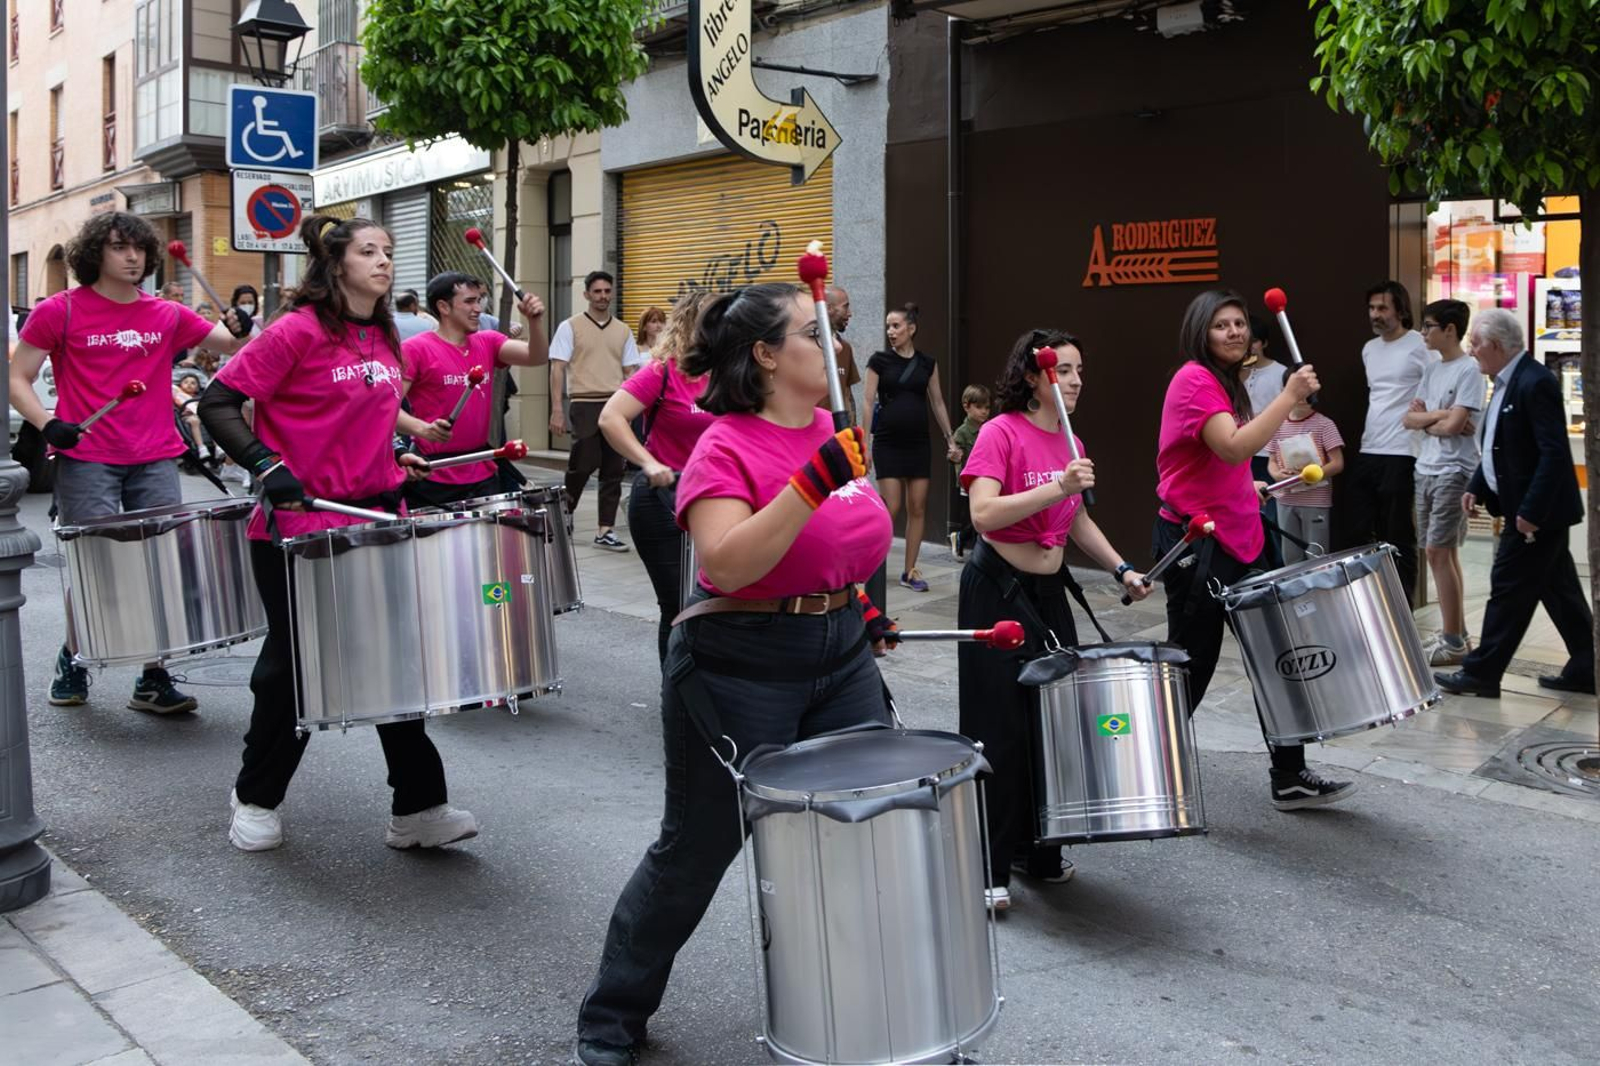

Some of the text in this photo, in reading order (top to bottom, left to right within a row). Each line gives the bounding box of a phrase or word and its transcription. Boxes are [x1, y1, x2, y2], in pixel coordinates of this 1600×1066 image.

[703, 0, 738, 48] libre
[706, 32, 749, 103] ANGELO
[236, 172, 271, 181] RESERVADO
[1112, 218, 1217, 251] RODRIGUEZ
